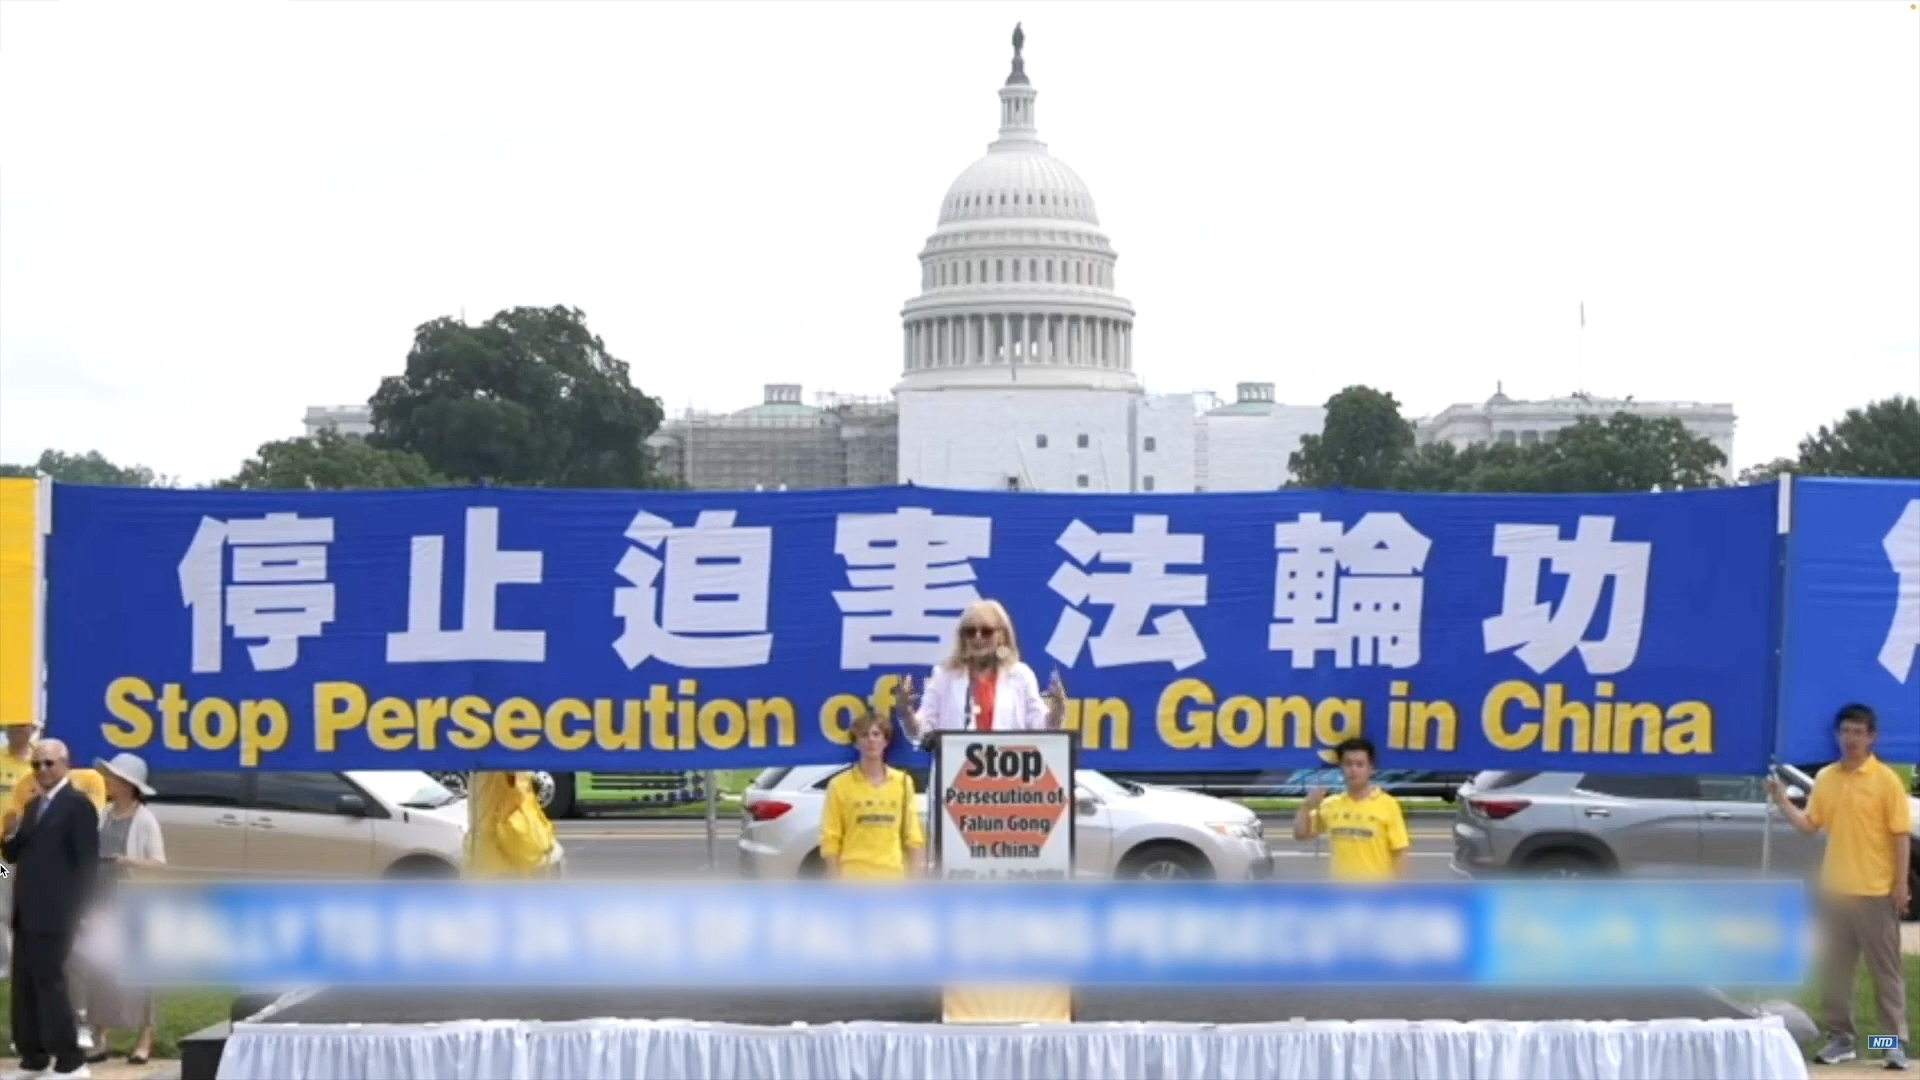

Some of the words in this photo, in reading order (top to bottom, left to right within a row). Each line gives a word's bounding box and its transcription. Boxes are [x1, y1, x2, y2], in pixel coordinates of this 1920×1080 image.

[178, 506, 1652, 675] 停止迫害法輪功
[101, 676, 290, 767] Stop
[313, 679, 796, 752] Persecution
[820, 675, 898, 745] of
[1156, 678, 1361, 765] Gong
[1387, 680, 1459, 751] in
[1481, 680, 1714, 755] China
[965, 742, 1042, 783] Stop
[946, 788, 1043, 804] Persecution
[1048, 788, 1064, 804] of
[959, 815, 1004, 833] Falun
[1007, 815, 1050, 834] Gong
[970, 841, 987, 859] in
[990, 841, 1040, 859] China
